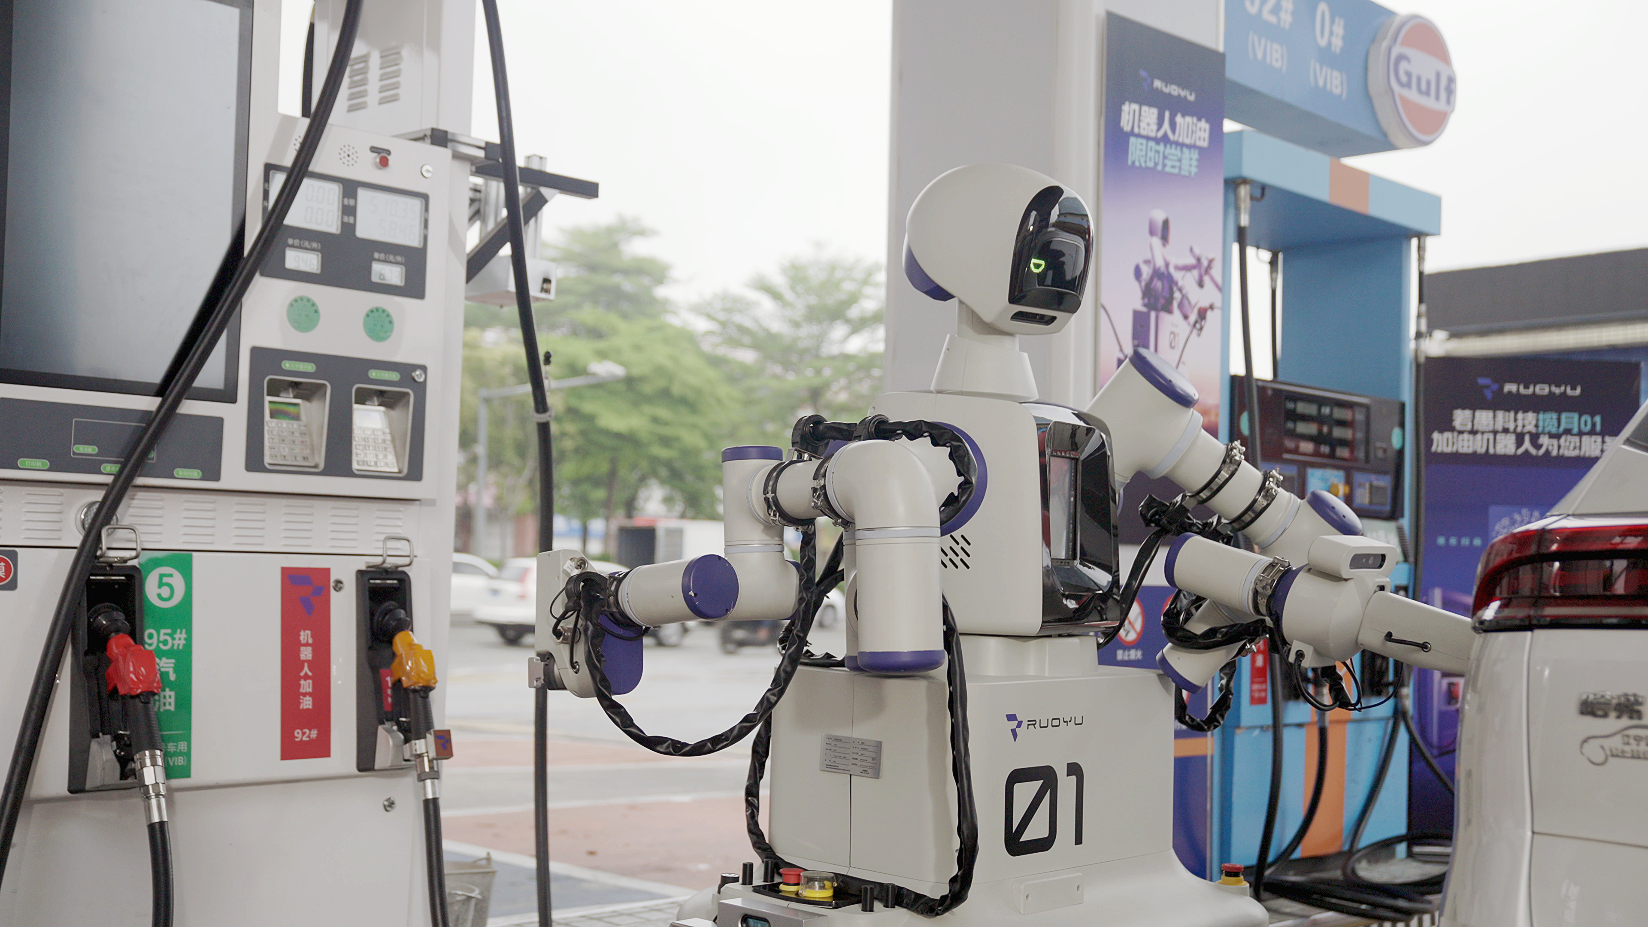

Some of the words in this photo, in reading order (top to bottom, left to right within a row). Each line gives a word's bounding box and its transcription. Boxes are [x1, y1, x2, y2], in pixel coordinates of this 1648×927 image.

[1315, 1, 1345, 54] 0#
[1248, 30, 1287, 74] (VIB)
[1152, 79, 1196, 102] RUOYU
[1309, 58, 1347, 101] (VIB)
[1393, 52, 1455, 106] Gulf
[1120, 100, 1211, 148] 机器人加油
[1127, 136, 1199, 178] 限时尝鲜
[1502, 382, 1582, 397] RUOYU
[156, 573, 175, 602] 5
[144, 628, 187, 651] 95#
[154, 657, 176, 712] 汽油
[299, 629, 313, 710] 机器人加油
[294, 728, 318, 742] 92#
[1026, 716, 1084, 730] RUOYU
[1004, 762, 1085, 858] 01
